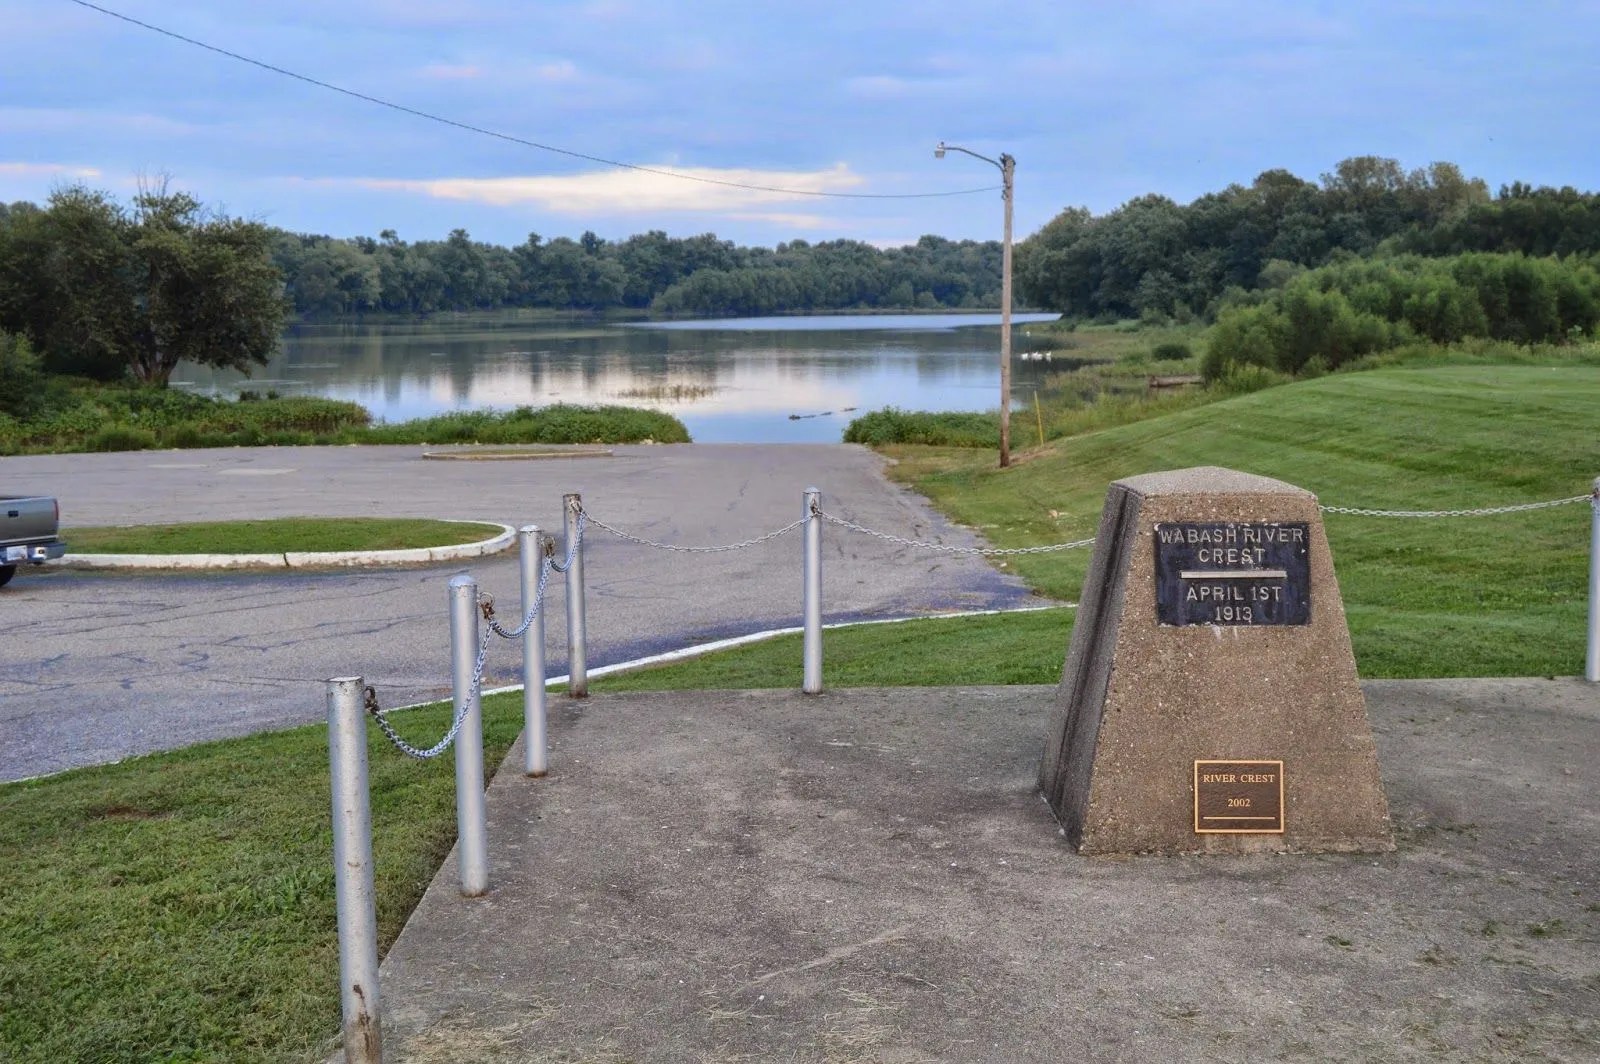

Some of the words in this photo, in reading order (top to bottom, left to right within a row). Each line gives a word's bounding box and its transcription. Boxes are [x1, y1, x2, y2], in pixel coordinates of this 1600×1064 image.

[1160, 529, 1237, 543] WABASH
[1244, 528, 1304, 543] RIVER
[1199, 548, 1266, 563] CREST
[1186, 586, 1245, 601] APRIL
[1252, 586, 1282, 601] 1ST
[1215, 606, 1252, 621] 1913
[1203, 774, 1236, 783] RIVER
[1240, 774, 1275, 783] CREST
[1227, 798, 1251, 807] 2002
